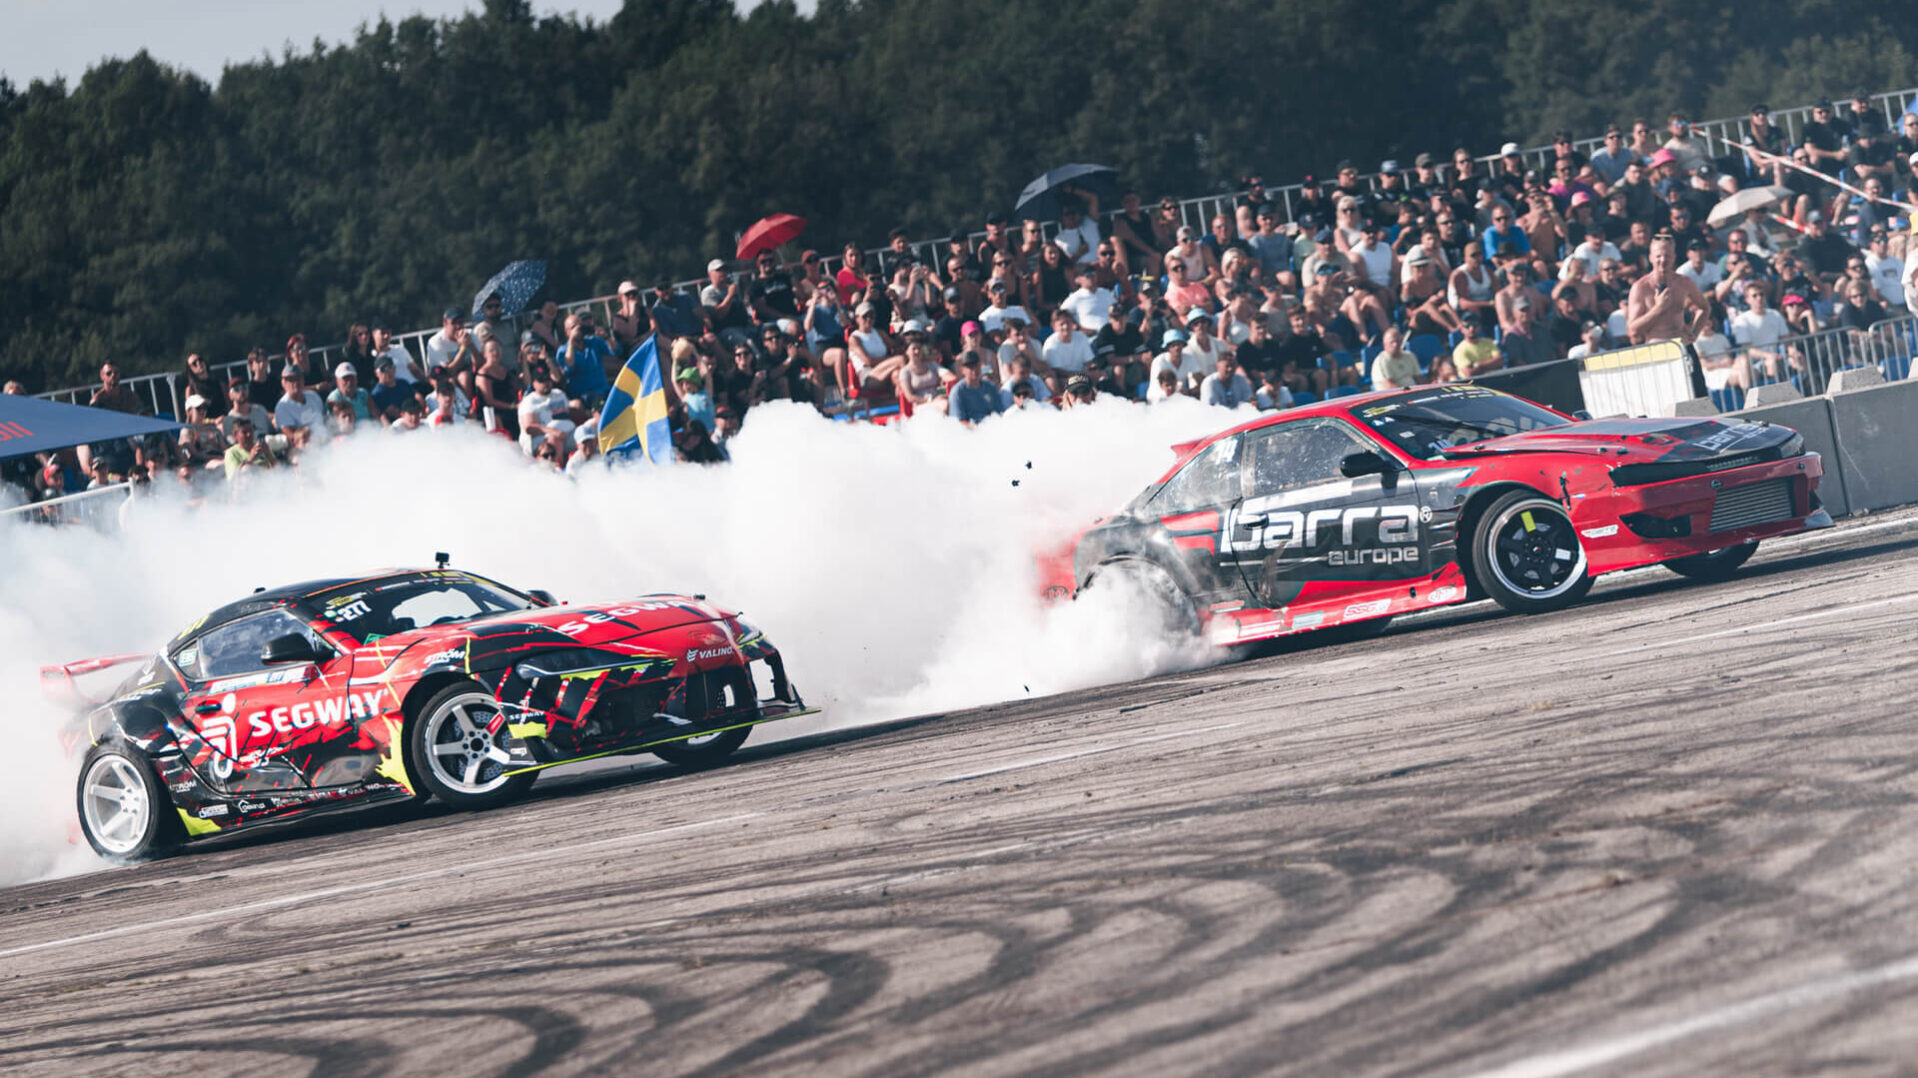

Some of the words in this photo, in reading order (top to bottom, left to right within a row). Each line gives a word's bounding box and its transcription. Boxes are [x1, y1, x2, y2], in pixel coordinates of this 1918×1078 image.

[1220, 505, 1419, 553] barra
[1328, 547, 1418, 566] europe
[337, 600, 372, 620] 277
[699, 646, 732, 659] VALINO
[248, 688, 386, 738] SEGWAY
[509, 711, 544, 720] SEWAY
